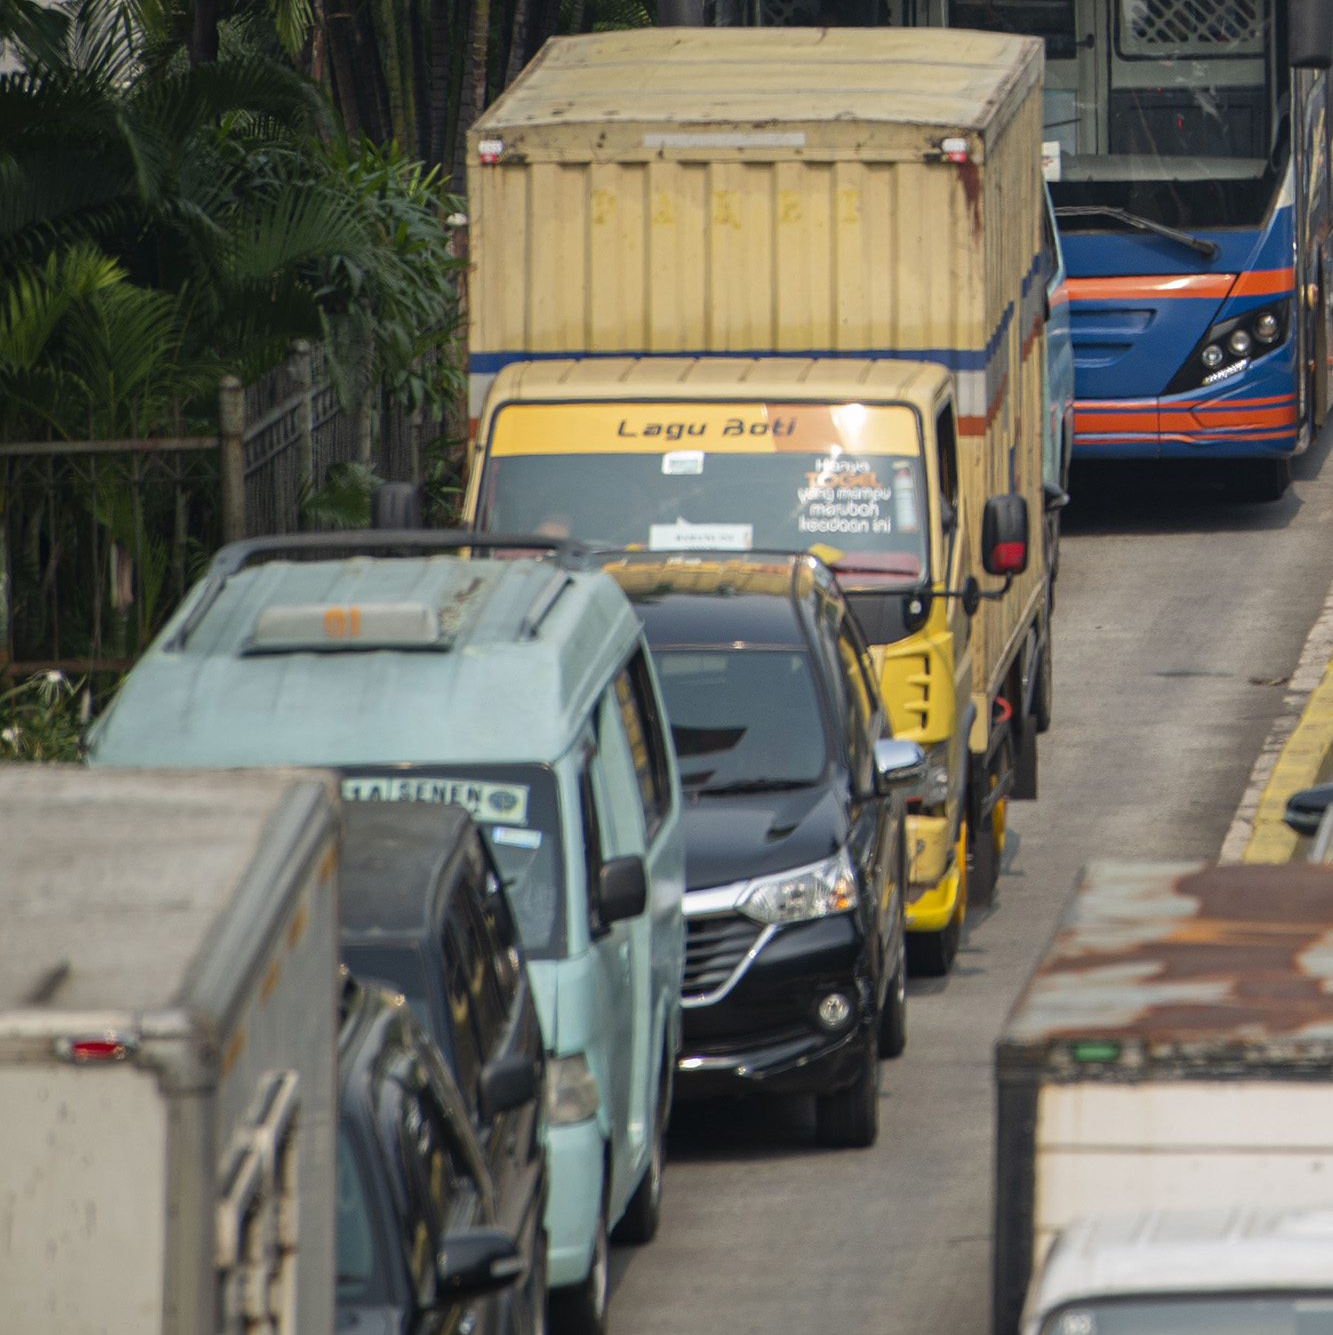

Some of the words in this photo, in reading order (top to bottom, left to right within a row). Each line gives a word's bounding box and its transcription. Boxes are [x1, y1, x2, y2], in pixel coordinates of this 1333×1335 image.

[617, 419, 707, 441] Lagu
[722, 417, 798, 438] Boti
[322, 605, 361, 638] 01
